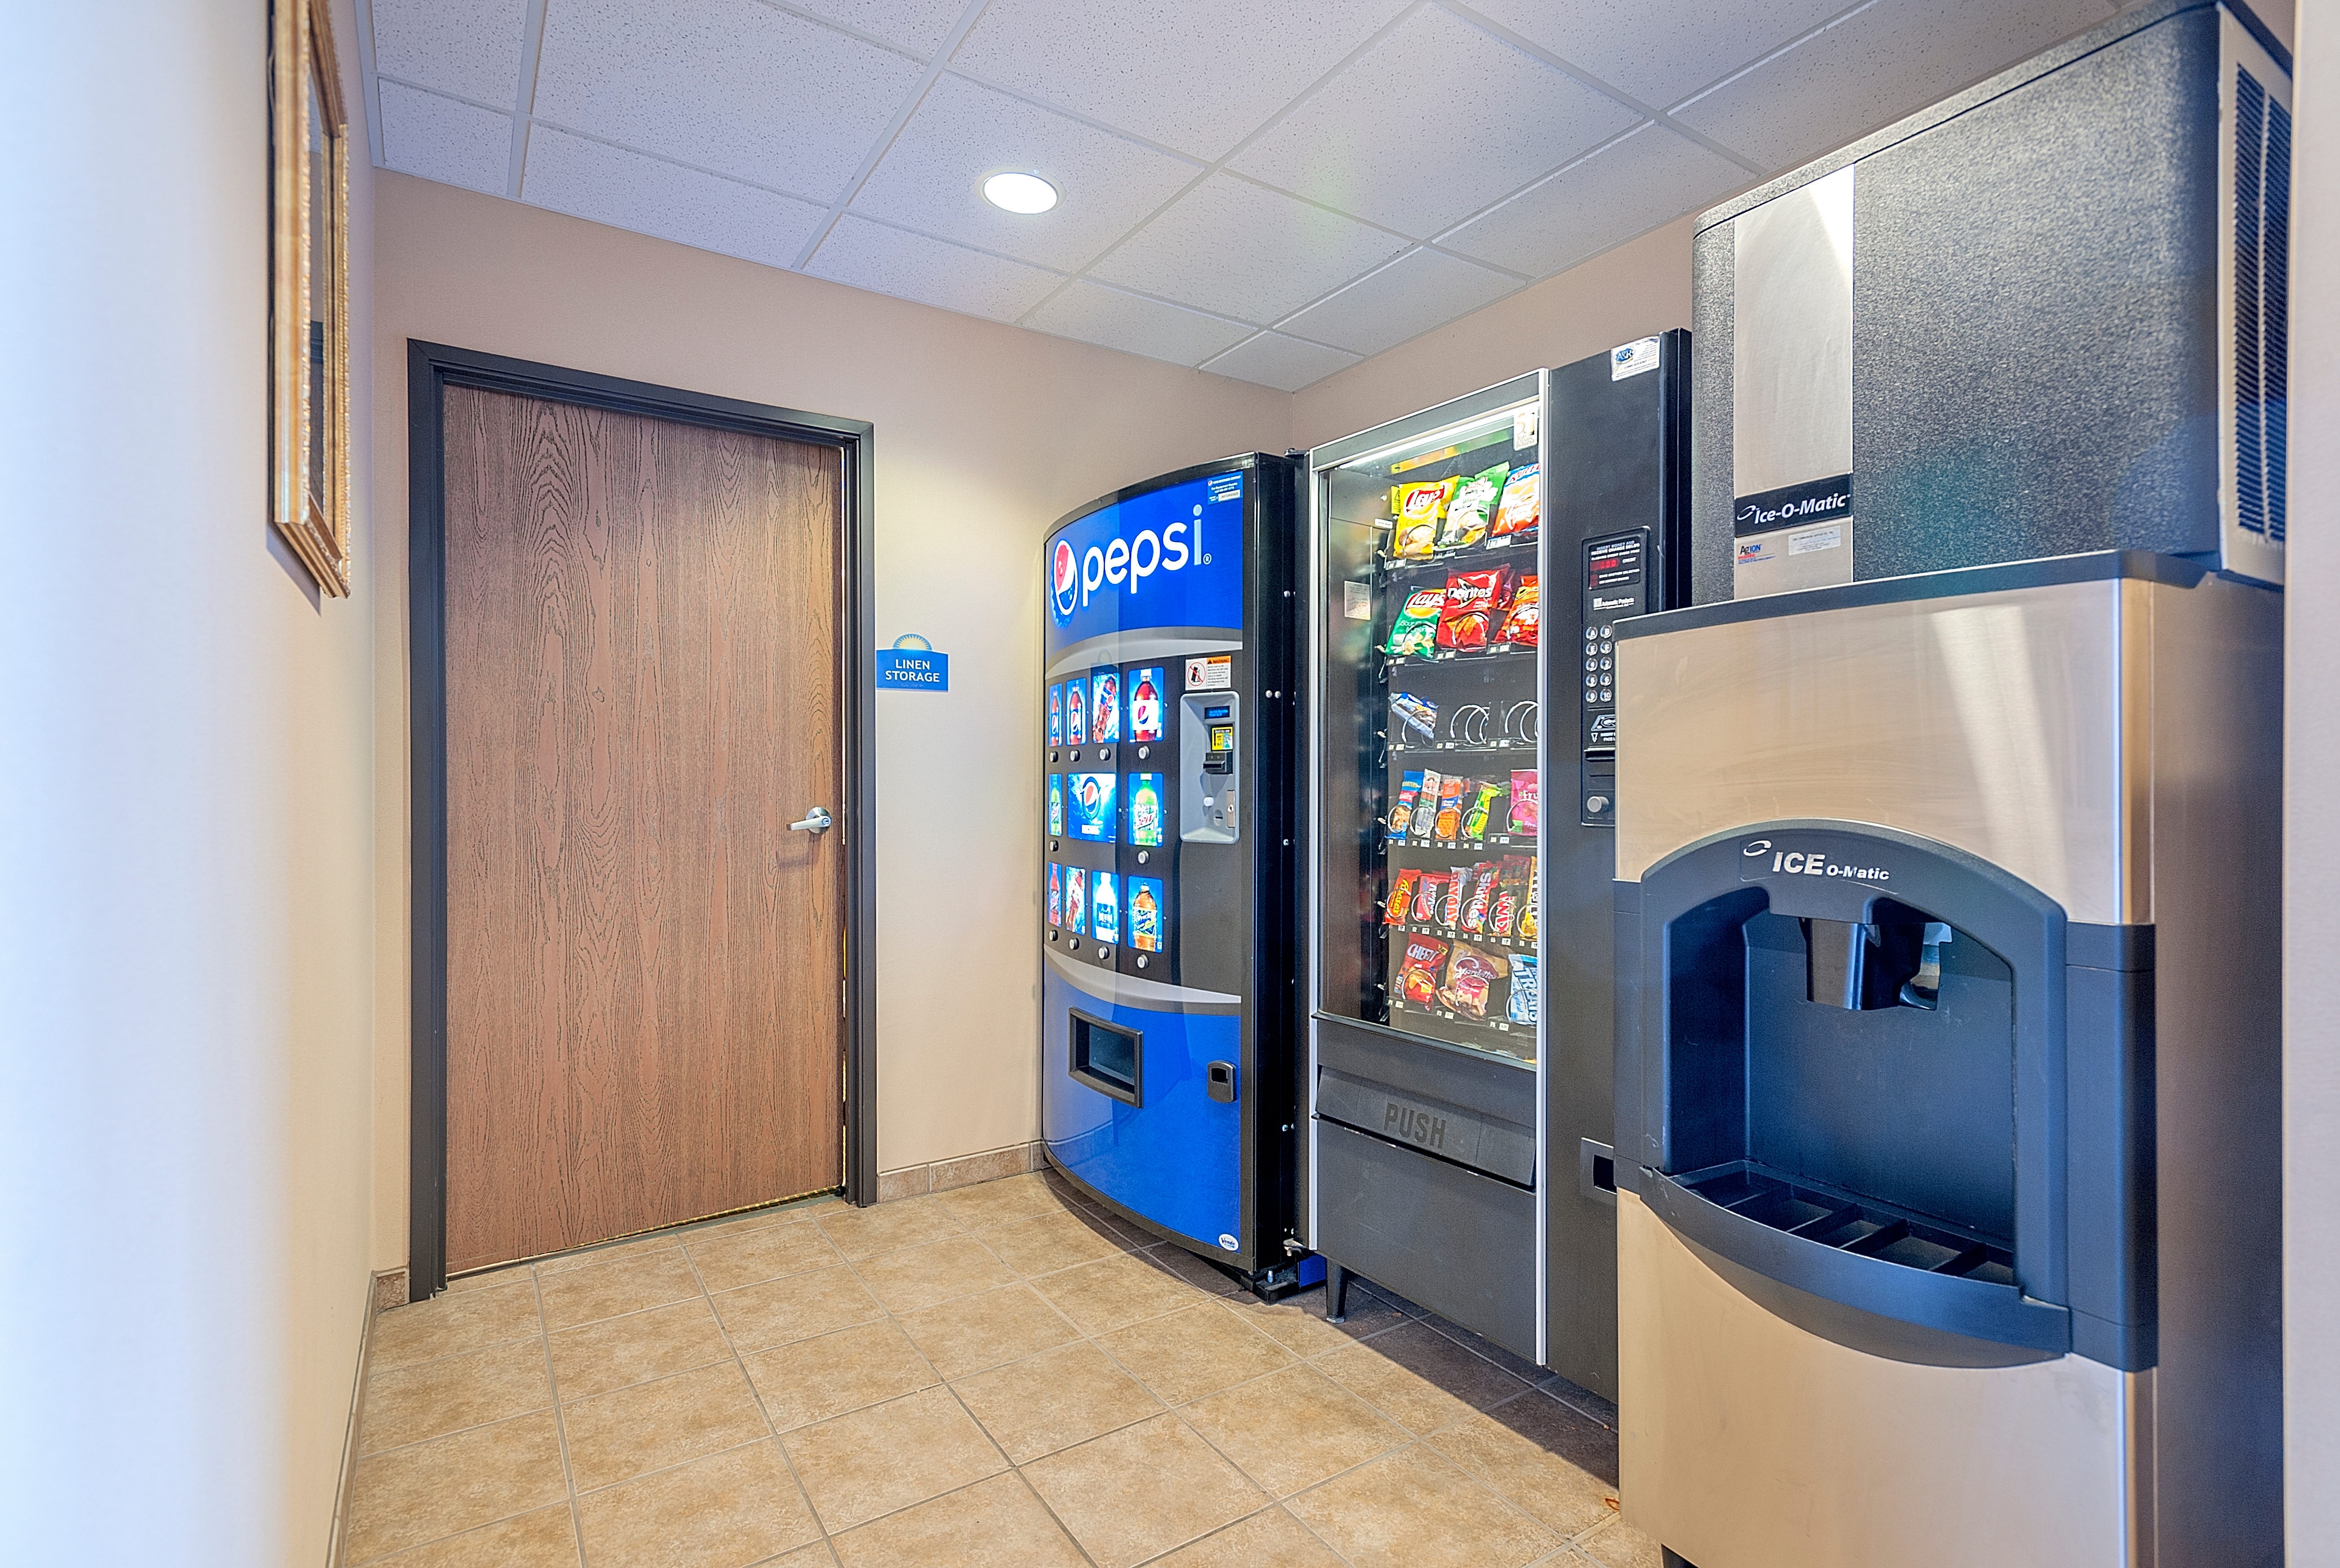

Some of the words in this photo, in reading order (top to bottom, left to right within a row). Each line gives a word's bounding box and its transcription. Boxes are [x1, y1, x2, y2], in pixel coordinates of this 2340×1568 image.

[1754, 493, 1846, 524] Ice-O-Matic
[1082, 504, 1202, 607] pepsi
[1407, 593, 1446, 608] Lay's
[1447, 587, 1492, 600] Doritos
[895, 659, 930, 670] LINEN
[885, 670, 940, 682] STORAGE
[1772, 852, 1826, 875] ICE
[1826, 865, 1889, 880] O-Matic
[1468, 872, 1491, 928] Skittles
[1384, 1102, 1446, 1148] PUSH
[1221, 1237, 1235, 1246] Vendo
